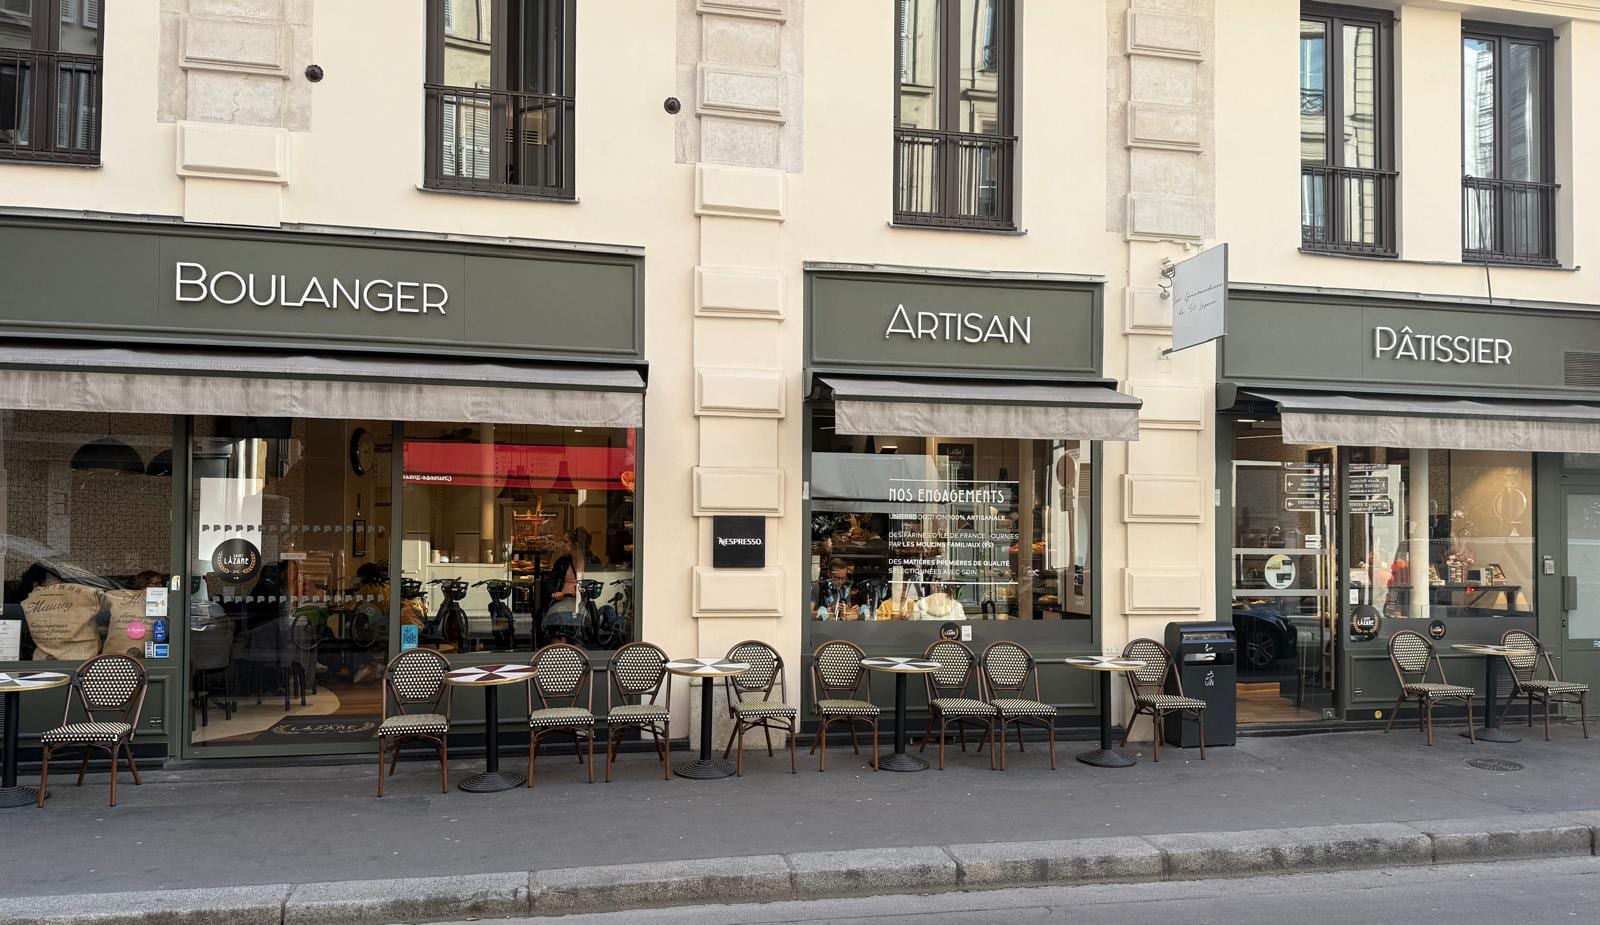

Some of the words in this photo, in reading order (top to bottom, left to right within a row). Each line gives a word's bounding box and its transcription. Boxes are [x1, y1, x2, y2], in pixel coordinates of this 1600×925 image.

[175, 261, 449, 315] BOULANGER
[885, 303, 1031, 344] ARTISAN
[1374, 325, 1513, 365] PÂTISSIER
[889, 488, 913, 502] NOS
[918, 488, 1005, 504] ENGAGEMENTS
[888, 531, 903, 539] DES
[717, 536, 763, 547] NESPRESSO
[947, 541, 980, 549] FAMILIAUX
[223, 555, 250, 565] LAZARE
[903, 557, 935, 566] MATIÈRES
[936, 557, 971, 567] PREMIÈRES
[971, 559, 982, 567] DE
[982, 559, 1010, 567] QUALITÉ
